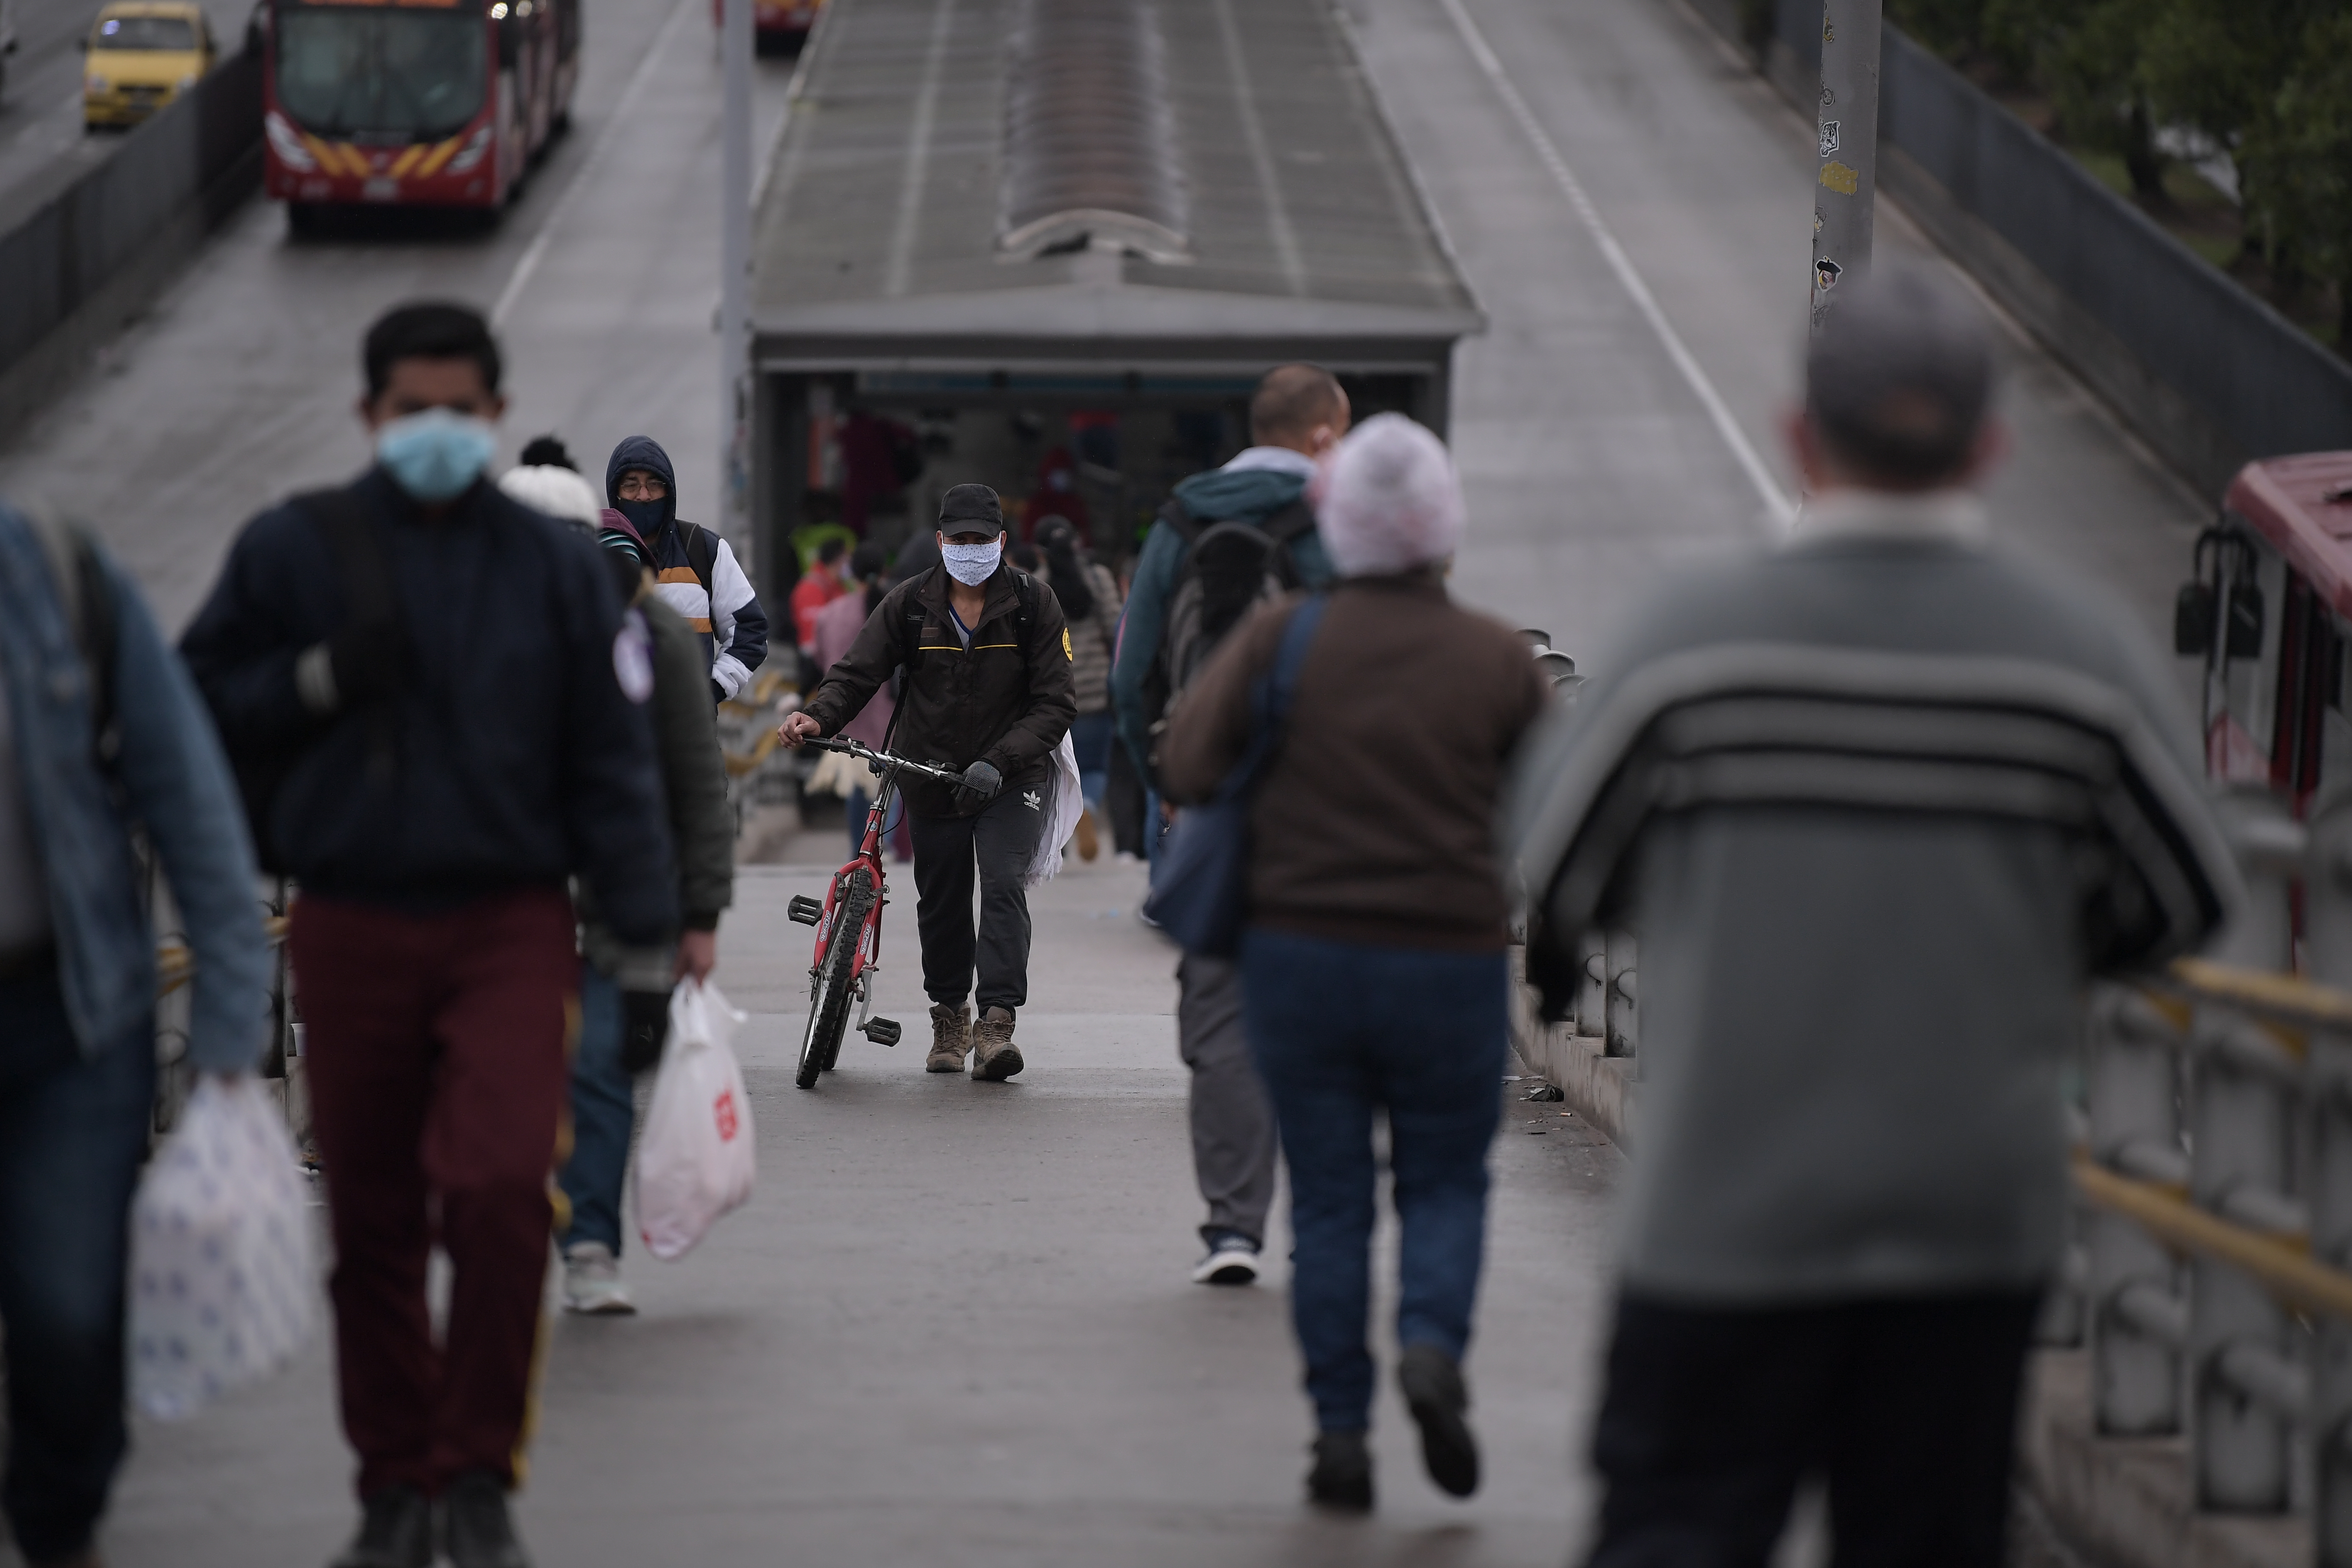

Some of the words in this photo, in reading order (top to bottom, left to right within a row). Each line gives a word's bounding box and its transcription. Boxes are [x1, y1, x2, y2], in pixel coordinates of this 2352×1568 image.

[1024, 801, 1040, 811] adidas
[819, 910, 831, 942] ROYAL
[860, 923, 872, 956] ROYAL
